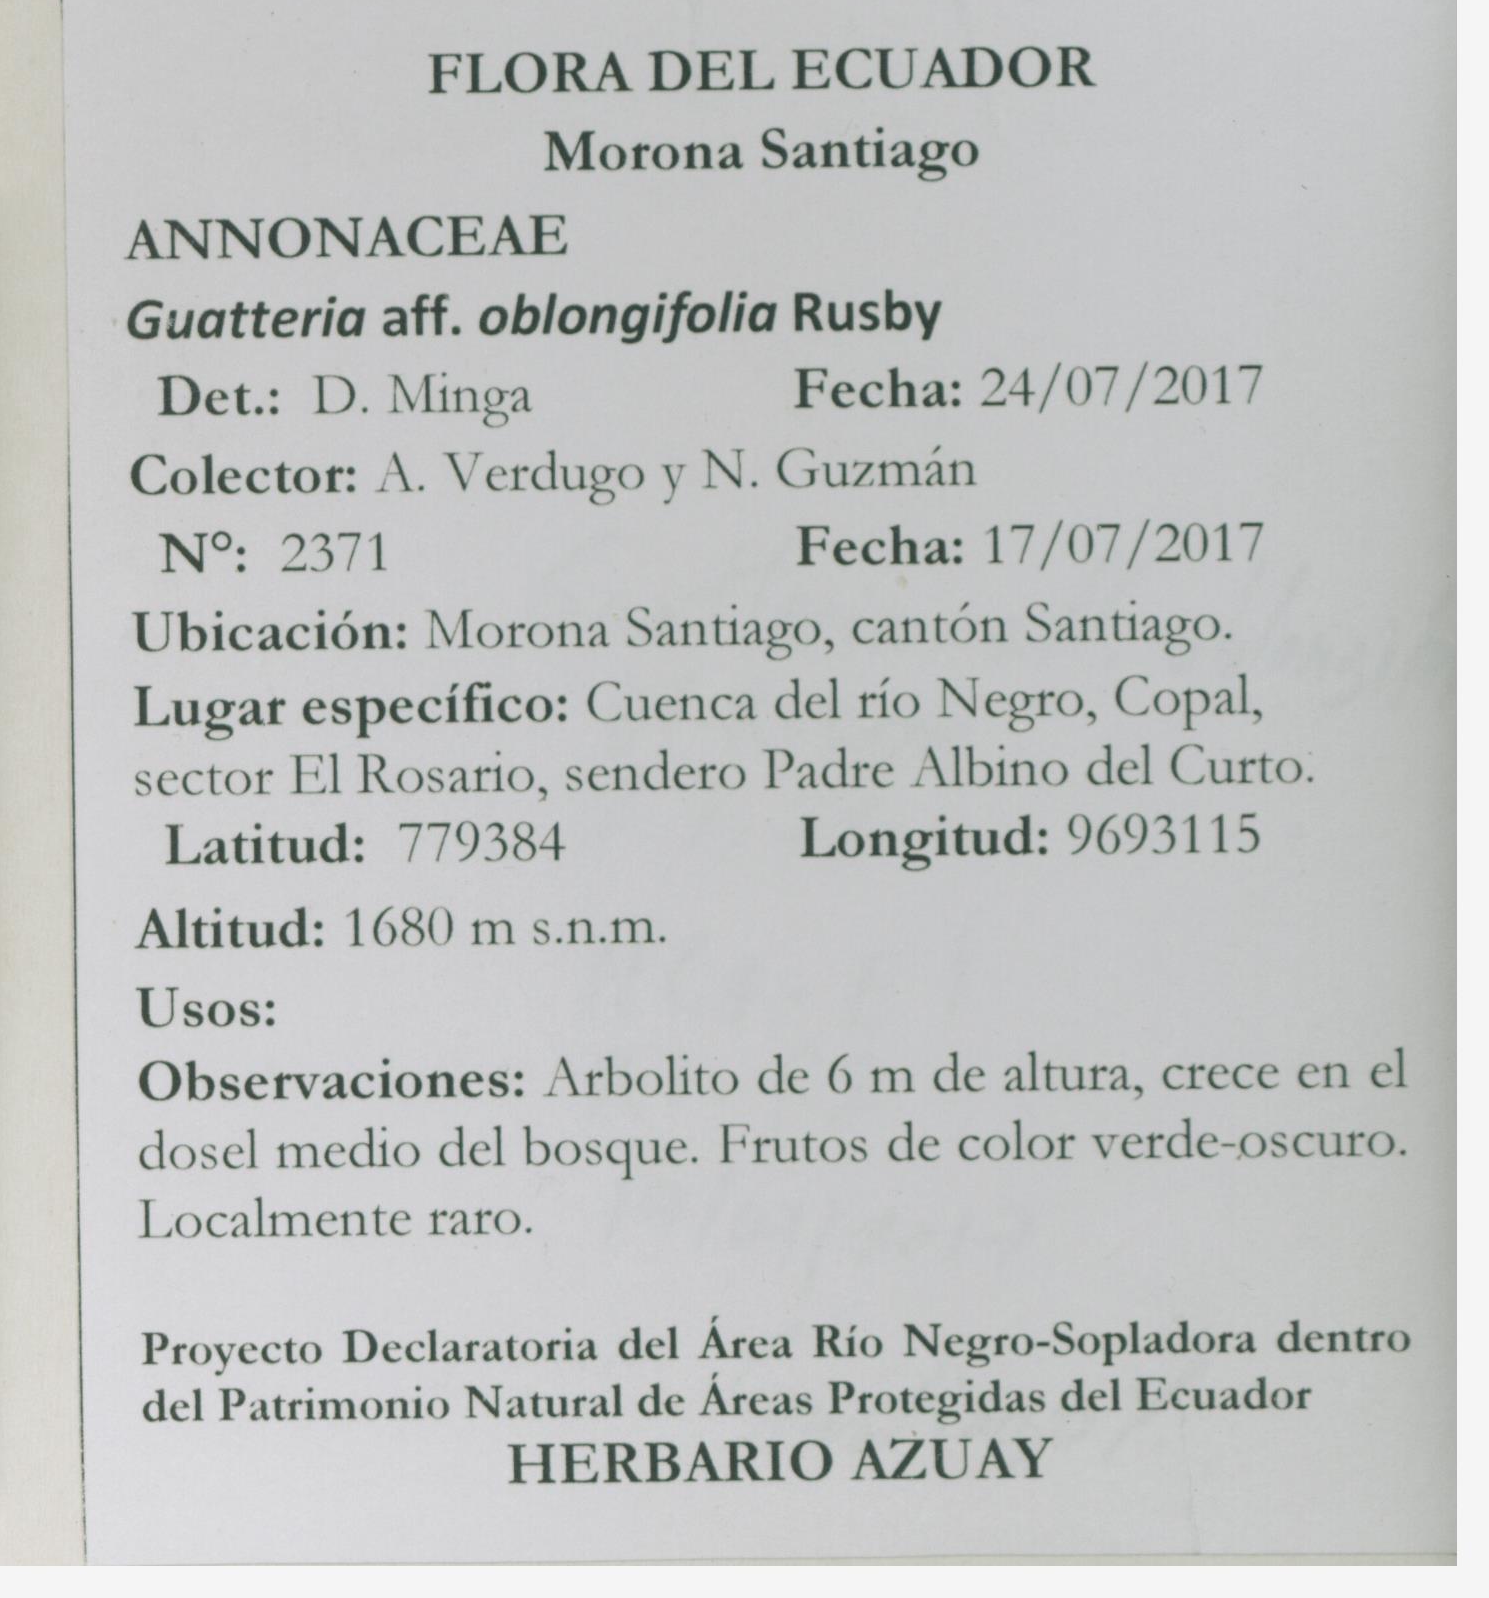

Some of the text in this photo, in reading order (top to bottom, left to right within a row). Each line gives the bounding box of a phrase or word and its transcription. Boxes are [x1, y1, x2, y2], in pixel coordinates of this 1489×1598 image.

[429, 46, 1096, 94] FLORA DEL ECUADOR
[544, 127, 979, 182] Morona Santiago
[125, 215, 567, 260] ANNONACEAE
[127, 289, 942, 344] Guatteria aff. oblongifolia Rusby
[158, 374, 531, 427] Det.: D. Minga
[795, 362, 1262, 413] Fecha: 24/07/2017
[131, 446, 976, 505] Colector: A. Verdugo y N. Guzmán
[282, 532, 385, 572] 2371
[797, 520, 1263, 570] Fecha: 17/07/2017
[132, 602, 1231, 660] Ubicación: Morona Santiago, cantón Santiago.
[134, 673, 1262, 741] Lugar específico: Cuenca del río Negro, Copal,
[135, 744, 1315, 800] sector El Rosario, sendero Padre Albino del Curto.
[166, 821, 565, 865] Latitud: 779384
[801, 813, 1260, 871] Longitud: 9693115
[135, 906, 665, 949] Altitud: 1680 m s.n.m.
[136, 987, 275, 1028] Usos:
[139, 1047, 1407, 1101] Observaciones: Arbolito de 6 m de altura, crece en el
[139, 1118, 1406, 1180] dosel medio del bosque. Frutos de color verde-oscuro.
[140, 1197, 533, 1238] Localmente raro.
[142, 1316, 1411, 1376] Proyecto Declaratoria del Área Río Negro-Sopladora dentro
[143, 1372, 1312, 1424] del Patrimonio Natural de Áreas Protegidas del Ecuador
[508, 1438, 1053, 1484] HERBARIO AZUAY
